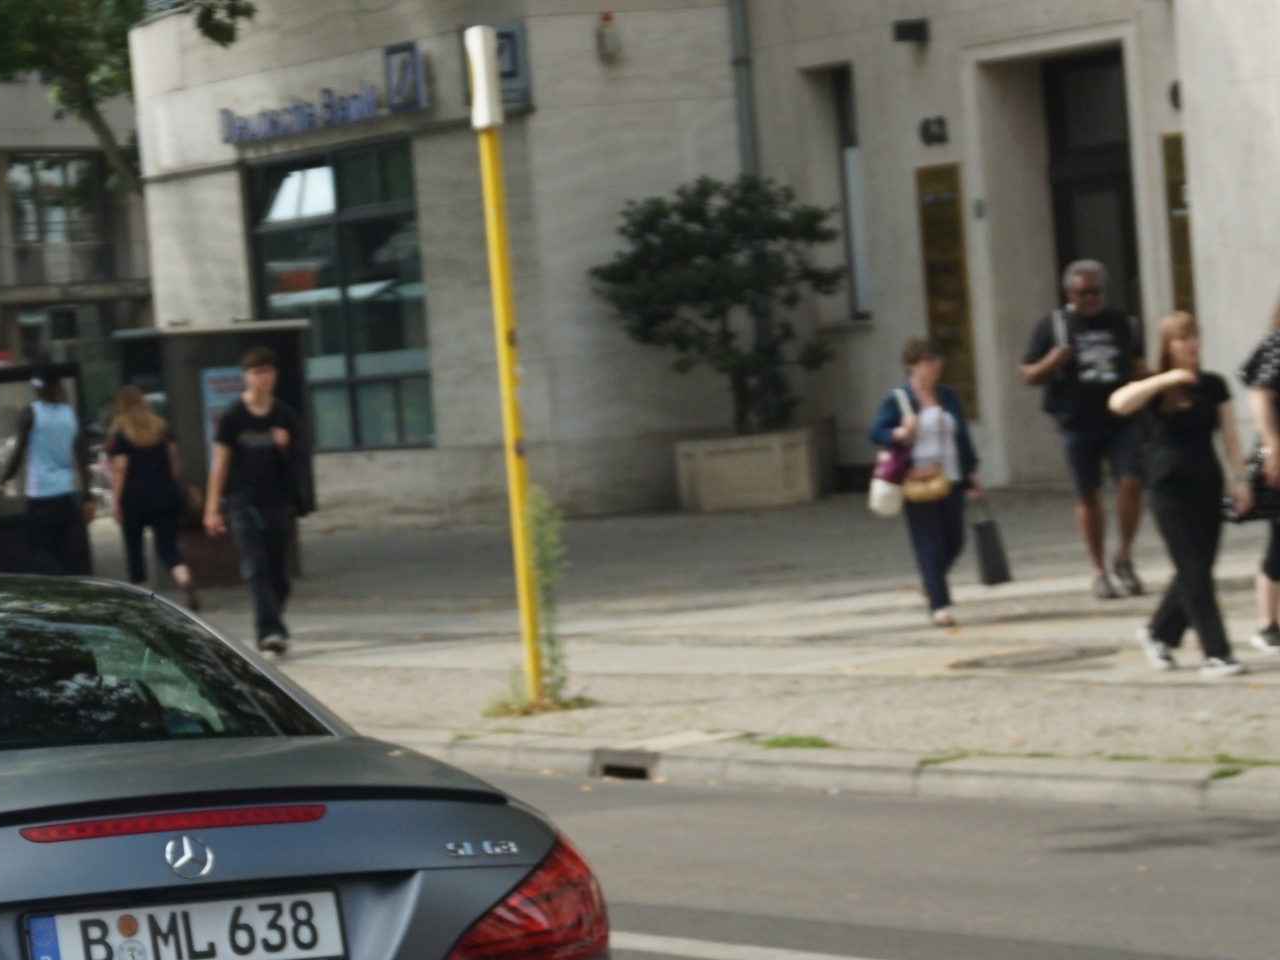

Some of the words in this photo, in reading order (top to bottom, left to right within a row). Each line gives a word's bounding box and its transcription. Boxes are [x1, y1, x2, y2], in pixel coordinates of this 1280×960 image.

[219, 97, 317, 144] Deutsche
[320, 80, 380, 125] Bank
[229, 900, 319, 956] 638
